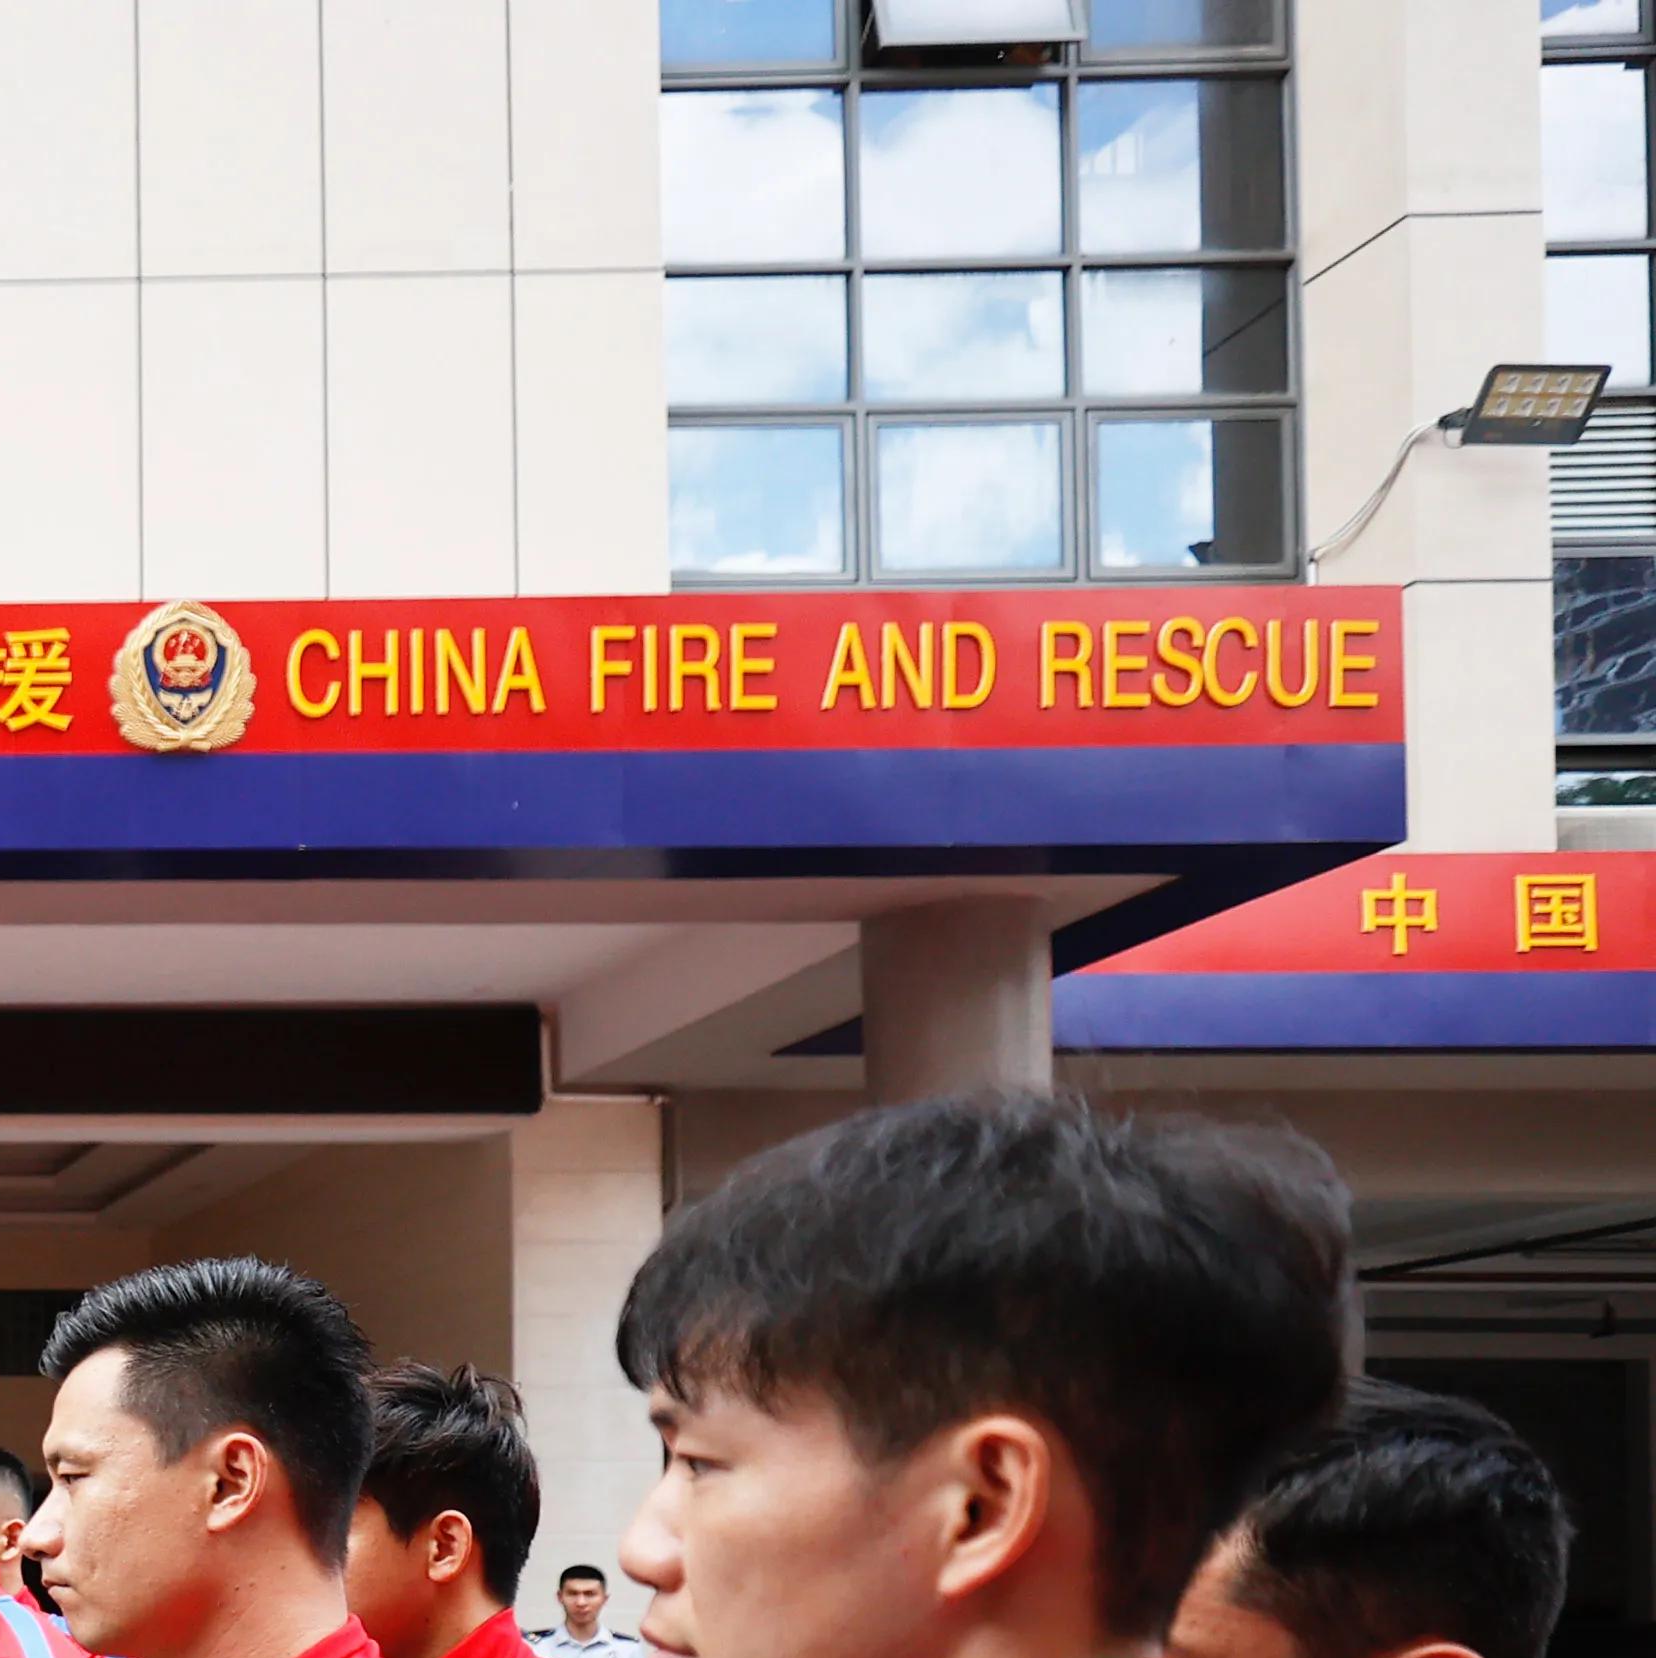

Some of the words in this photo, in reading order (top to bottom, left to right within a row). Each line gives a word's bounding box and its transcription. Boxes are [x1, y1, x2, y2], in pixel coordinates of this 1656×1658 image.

[286, 627, 548, 720] CHINA
[593, 623, 779, 714] FIRE
[824, 621, 997, 711] AND
[1043, 614, 1382, 710] RESCUE
[1359, 871, 1601, 956] 中国
